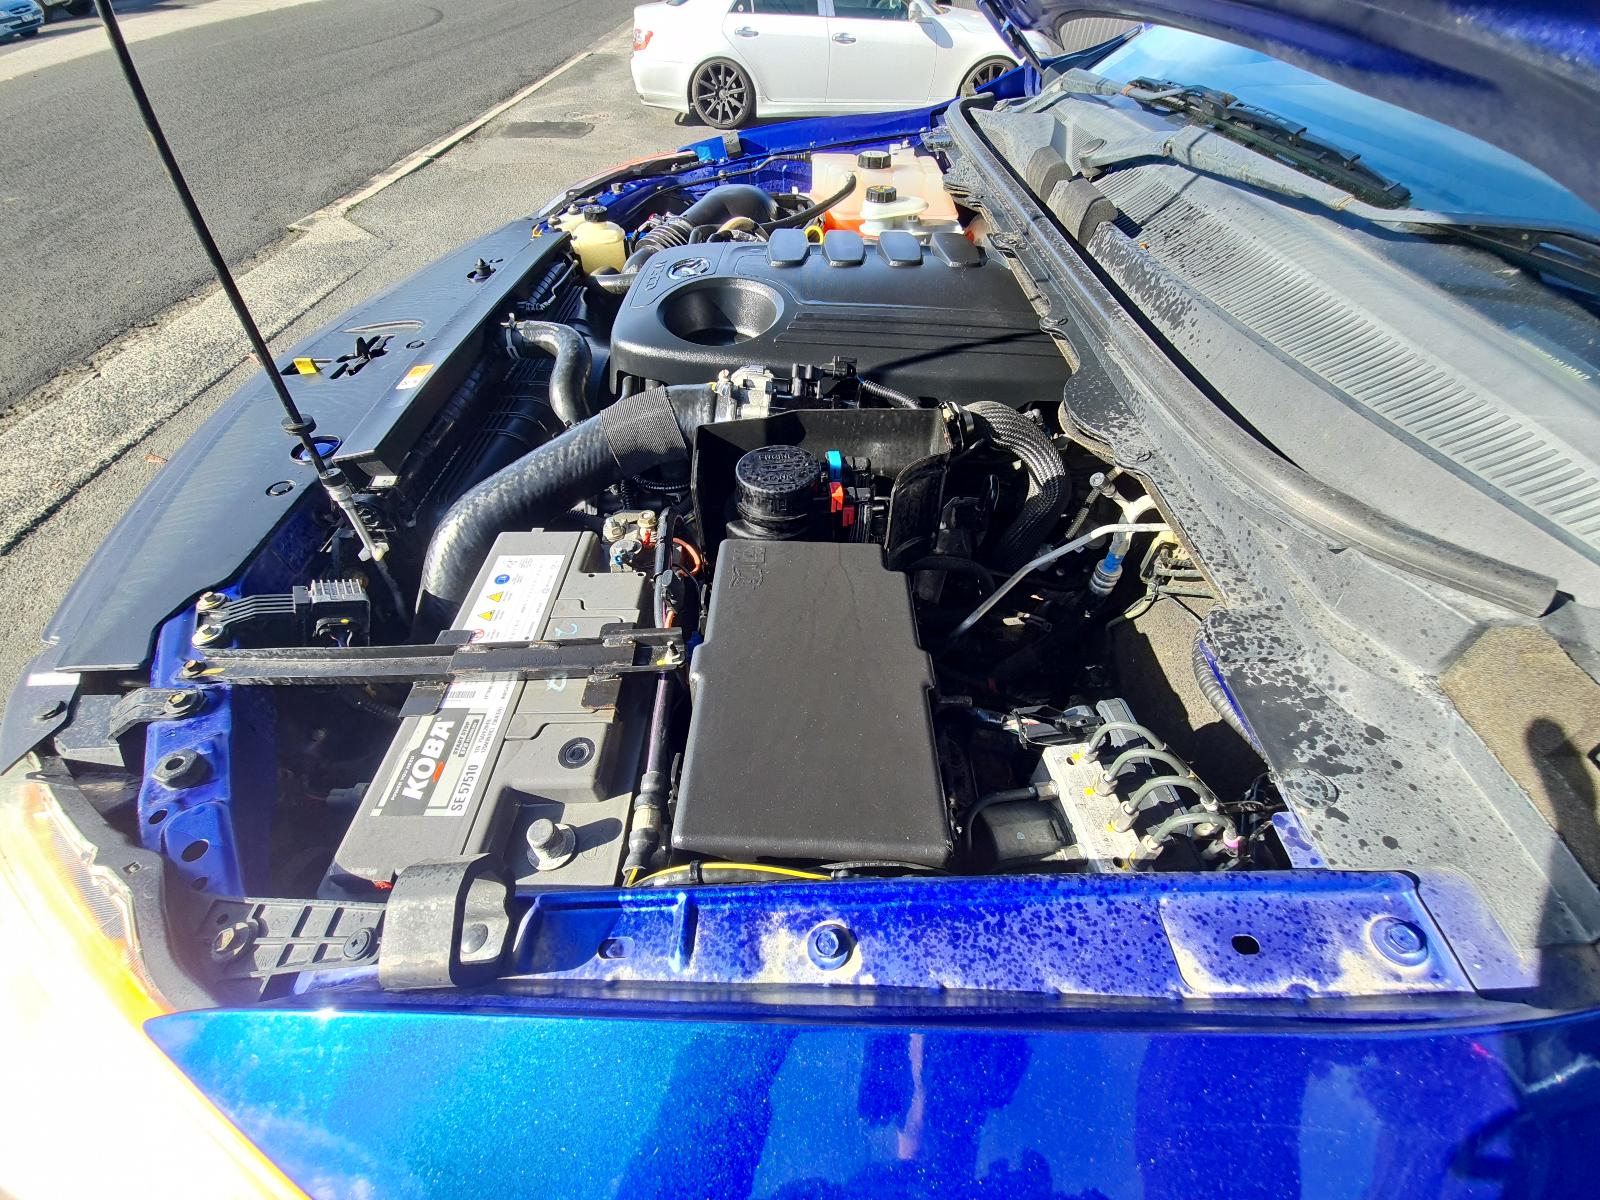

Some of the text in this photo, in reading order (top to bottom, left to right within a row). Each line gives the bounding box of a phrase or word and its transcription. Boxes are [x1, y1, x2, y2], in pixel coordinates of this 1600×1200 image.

[402, 721, 455, 800] KOBA
[452, 721, 470, 755] START STOP
[451, 764, 479, 811] SE 57510
